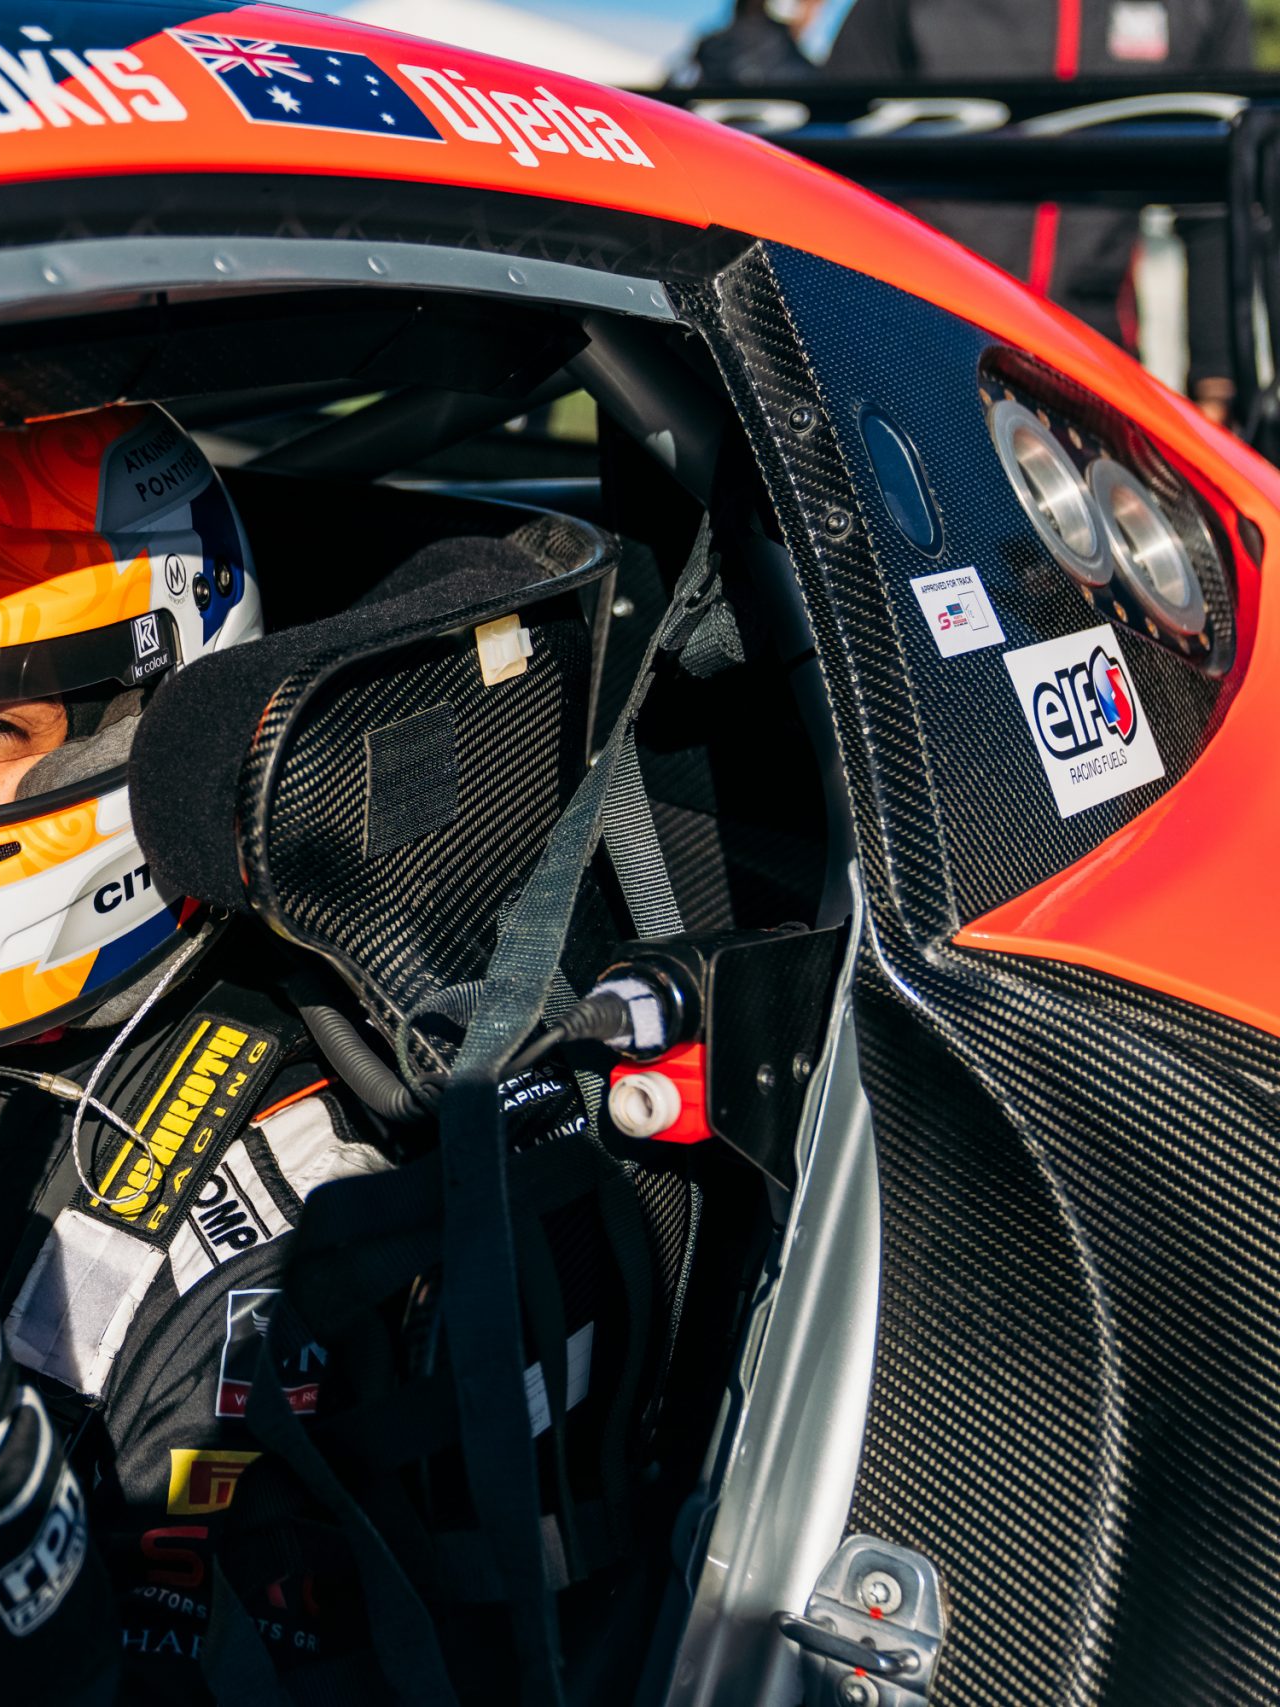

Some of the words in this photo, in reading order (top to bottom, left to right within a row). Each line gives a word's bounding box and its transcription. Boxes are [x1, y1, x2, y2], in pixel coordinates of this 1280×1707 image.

[397, 63, 656, 168] Ojeda
[921, 581, 947, 594] APPROVED
[947, 579, 958, 588] FOR
[956, 576, 974, 586] TRACK
[134, 665, 144, 679] kr
[144, 654, 169, 673] colour
[1034, 664, 1104, 758] elf
[1070, 756, 1103, 785] RACING
[1102, 748, 1129, 775] FUELS
[499, 1081, 562, 1113] APITAL
[147, 1041, 268, 1230] RACING
[197, 1174, 260, 1251] OMP
